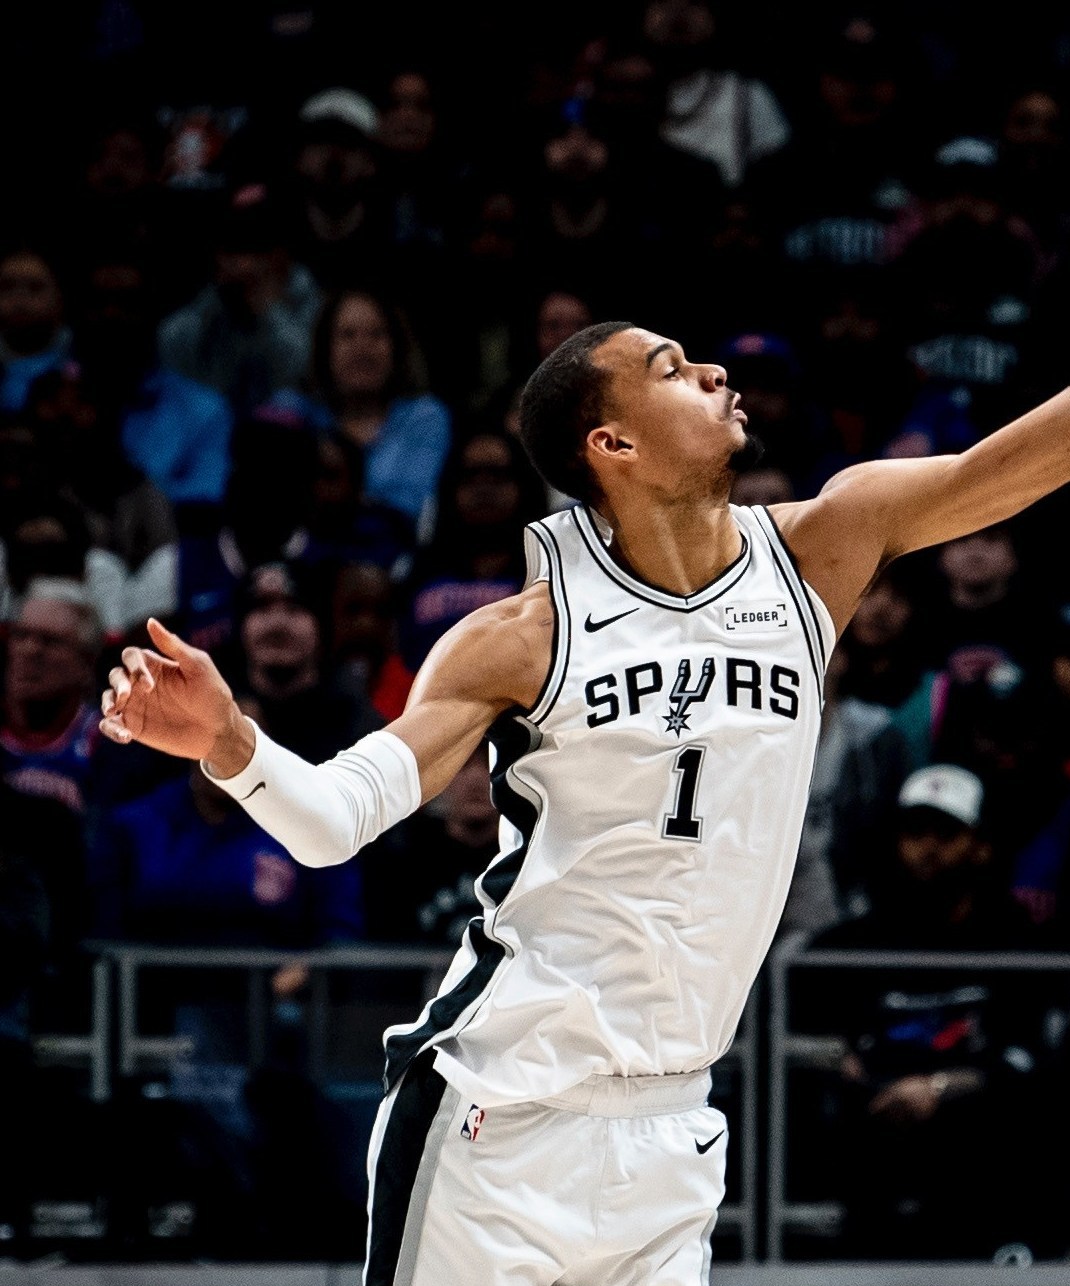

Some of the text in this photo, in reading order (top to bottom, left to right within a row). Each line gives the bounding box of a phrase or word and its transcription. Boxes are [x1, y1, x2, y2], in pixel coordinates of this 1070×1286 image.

[733, 611, 779, 624] LEDGER
[585, 657, 800, 738] SPURS
[661, 744, 707, 843] 1
